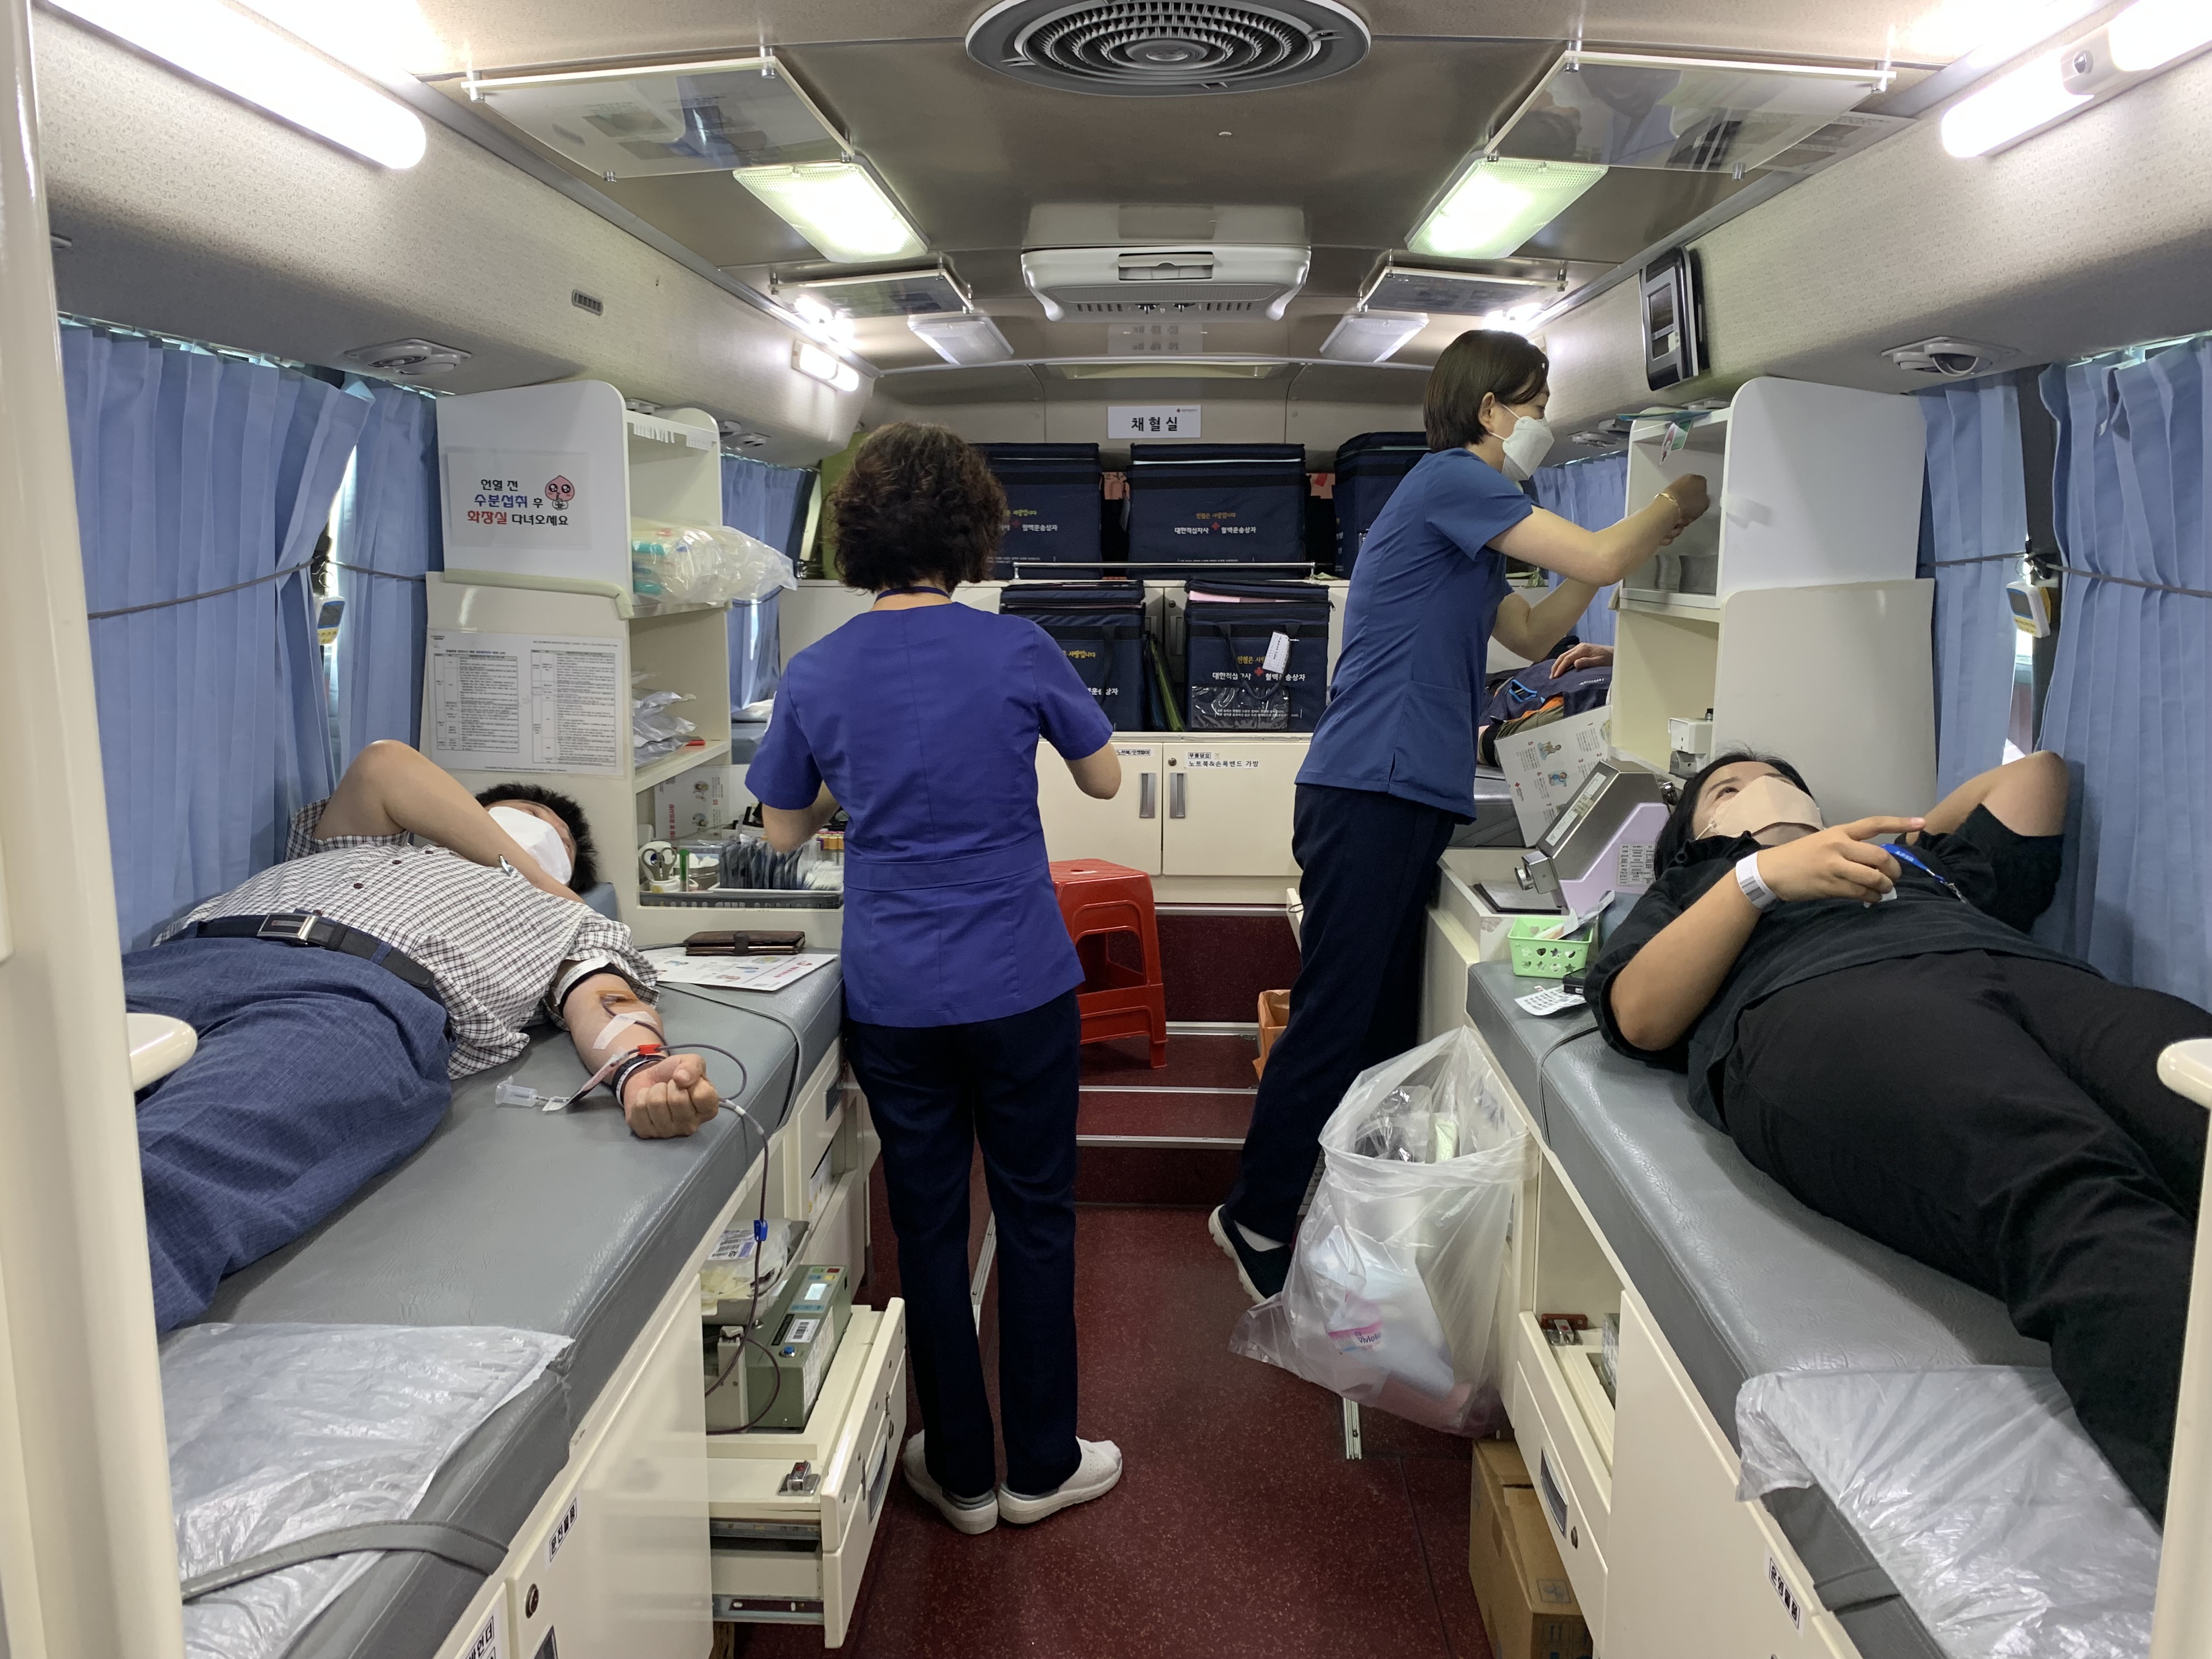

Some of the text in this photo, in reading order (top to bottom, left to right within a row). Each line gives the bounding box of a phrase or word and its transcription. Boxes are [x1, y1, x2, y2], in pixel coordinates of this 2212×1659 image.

[507, 480, 518, 492] 전
[474, 494, 544, 509] 수분섭취 후
[467, 510, 568, 526] 화장실 다녀오세요
[1265, 673, 1306, 681] 혈액송상자
